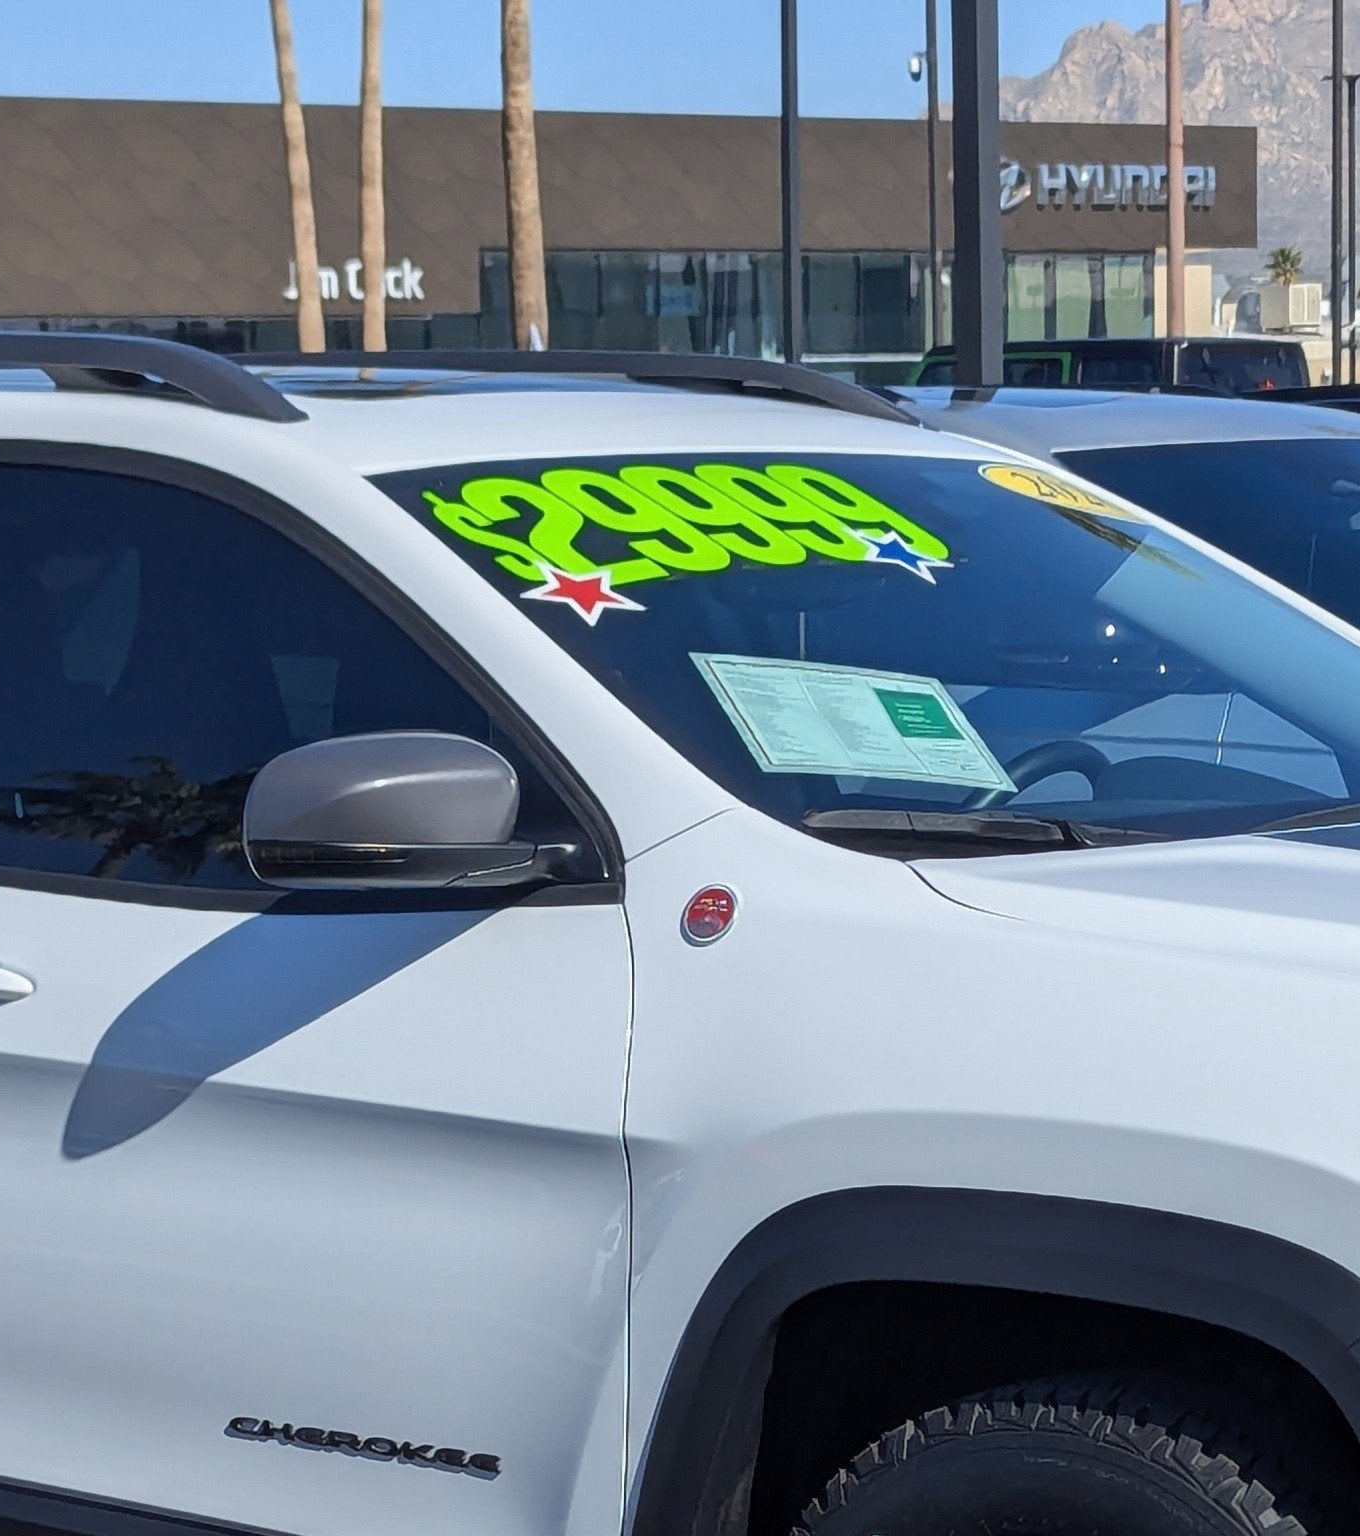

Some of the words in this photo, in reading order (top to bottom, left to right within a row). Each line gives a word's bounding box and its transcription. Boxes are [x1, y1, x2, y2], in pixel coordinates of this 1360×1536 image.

[1037, 163, 1215, 206] HYUNDAI
[423, 464, 948, 586] $29999
[224, 1416, 503, 1481] CHEROKEE
